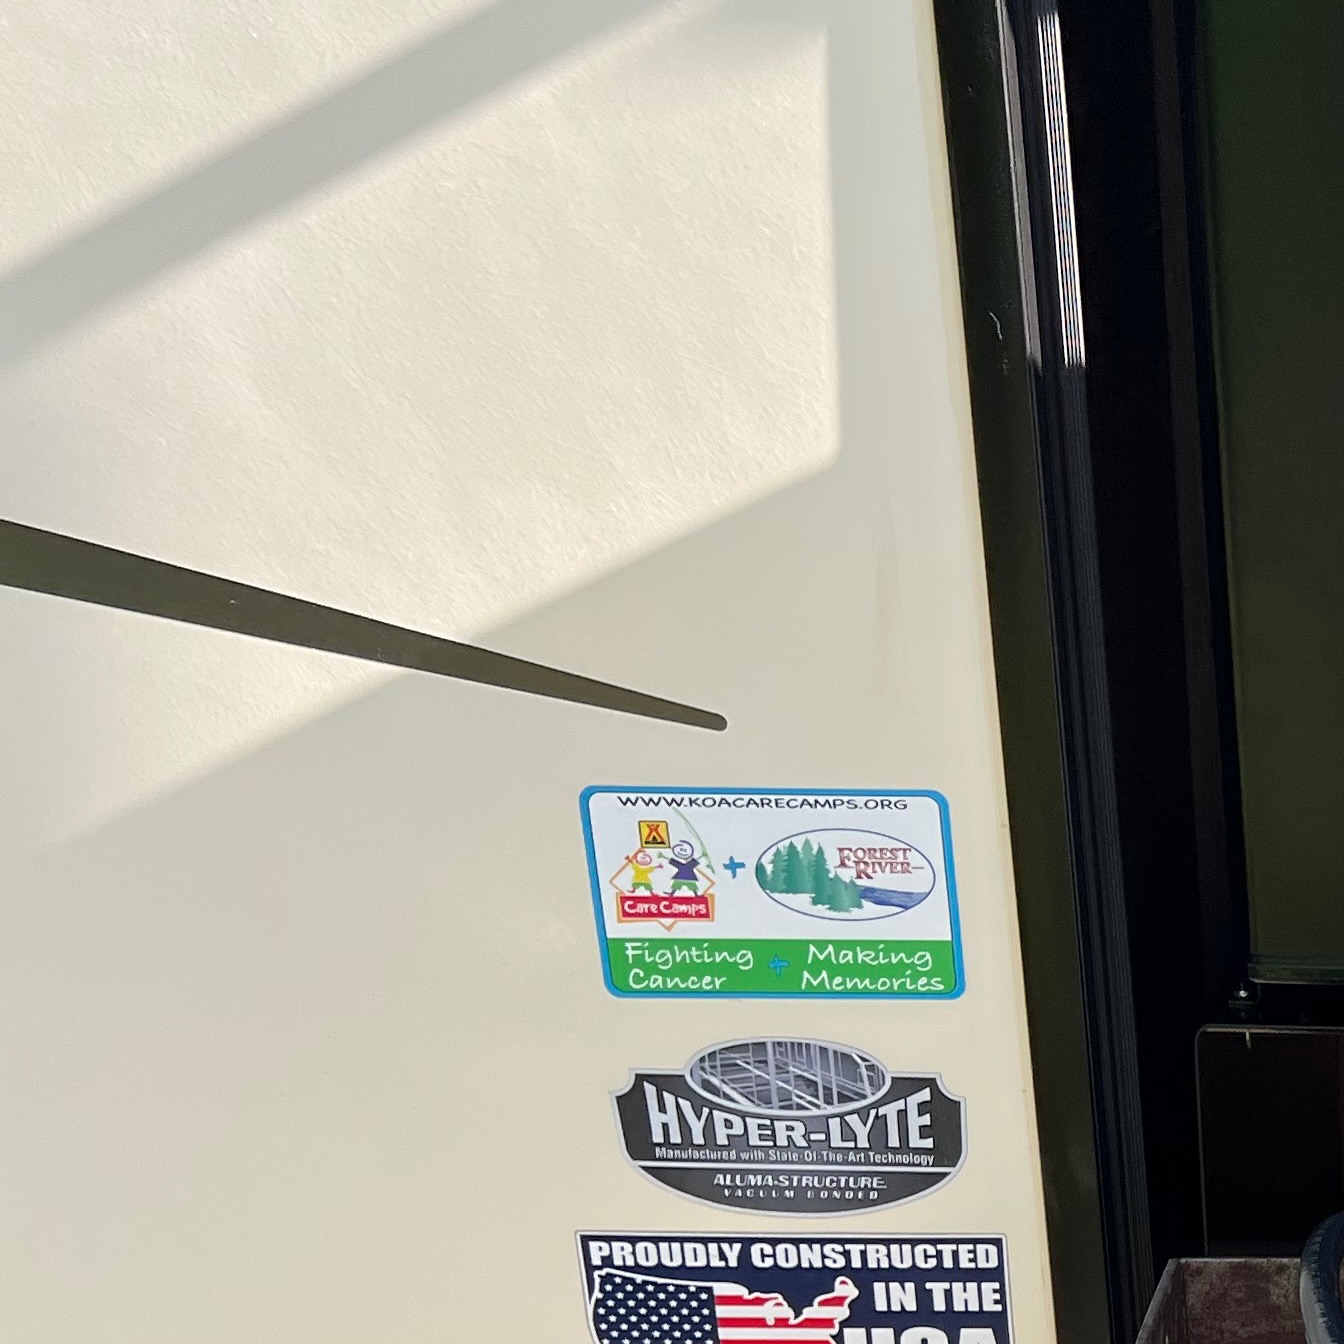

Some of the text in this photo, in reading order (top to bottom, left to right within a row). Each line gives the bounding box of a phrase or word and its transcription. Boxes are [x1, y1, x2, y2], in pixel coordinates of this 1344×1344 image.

[616, 796, 908, 811] WWW.KOACARECAMPS.ORG
[835, 846, 912, 869] FOREST
[853, 861, 911, 880] RIVER
[624, 901, 707, 916] Care Camps
[624, 942, 933, 970] Fighting Making
[628, 969, 945, 992] Cancer Memories
[643, 1080, 935, 1149] HYPER-LYTE
[655, 1146, 737, 1160] Manufactured
[740, 1148, 766, 1161] with
[868, 1151, 935, 1166] Technology
[724, 1188, 795, 1198] VACUUM
[588, 1240, 999, 1270] PROUDLY CONSTRUCTED
[872, 1281, 1002, 1313] IN THE
